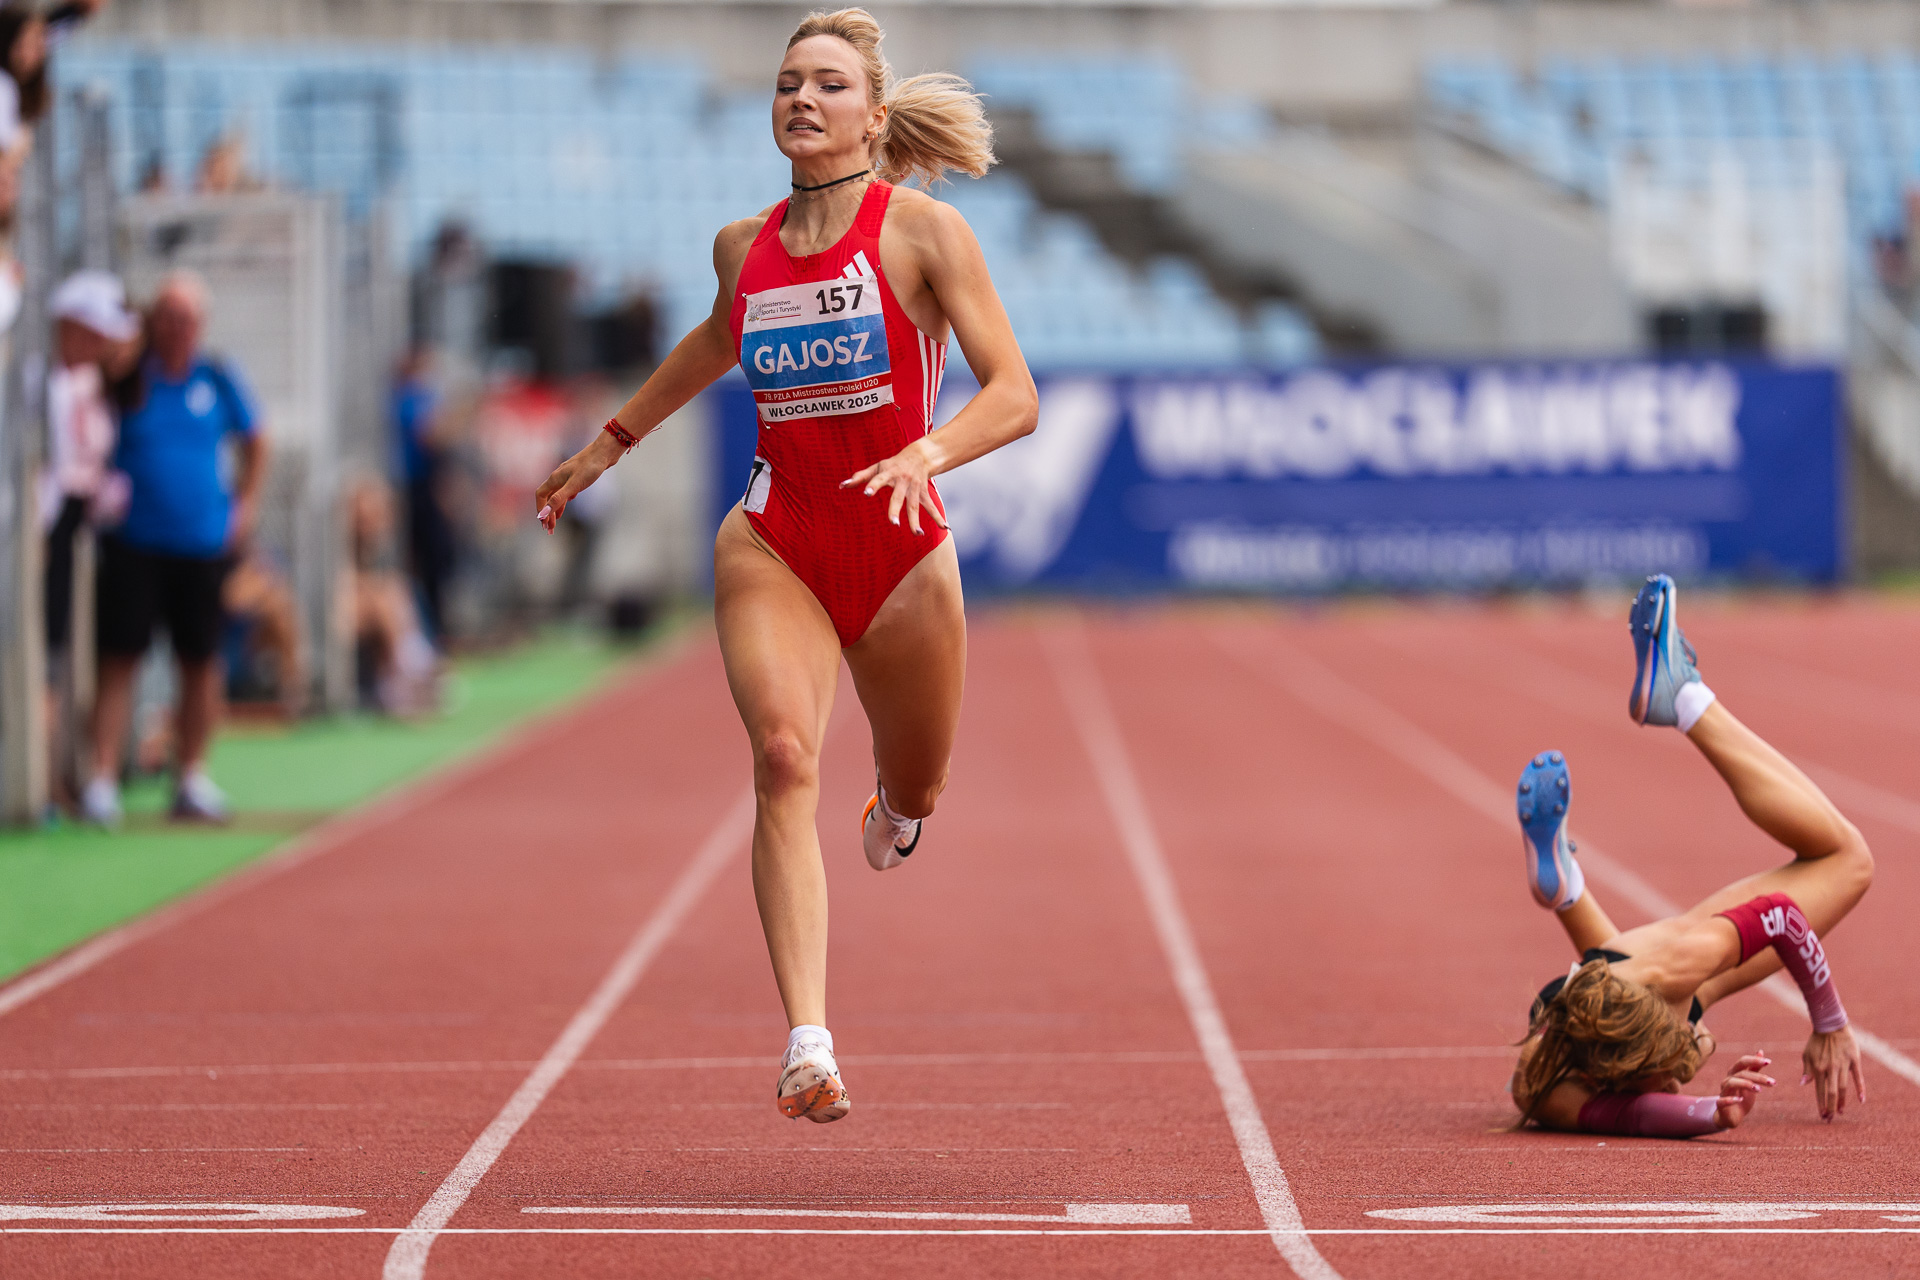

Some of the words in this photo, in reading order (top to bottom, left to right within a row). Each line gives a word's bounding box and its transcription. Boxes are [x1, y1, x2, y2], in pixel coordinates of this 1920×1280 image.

[761, 300, 791, 308] Ministerstwo
[780, 304, 802, 313] Turystyki
[816, 284, 863, 315] 157
[754, 332, 872, 374] GAJOSZ
[774, 391, 792, 401] PZLA
[792, 386, 838, 398] Mistrzostwa
[839, 382, 863, 393] Polski
[863, 378, 879, 389] U20
[768, 400, 846, 418] WŁOCŁAWEK
[847, 393, 879, 409] 2025
[744, 460, 765, 505] 7
[521, 1203, 1193, 1224] 7
